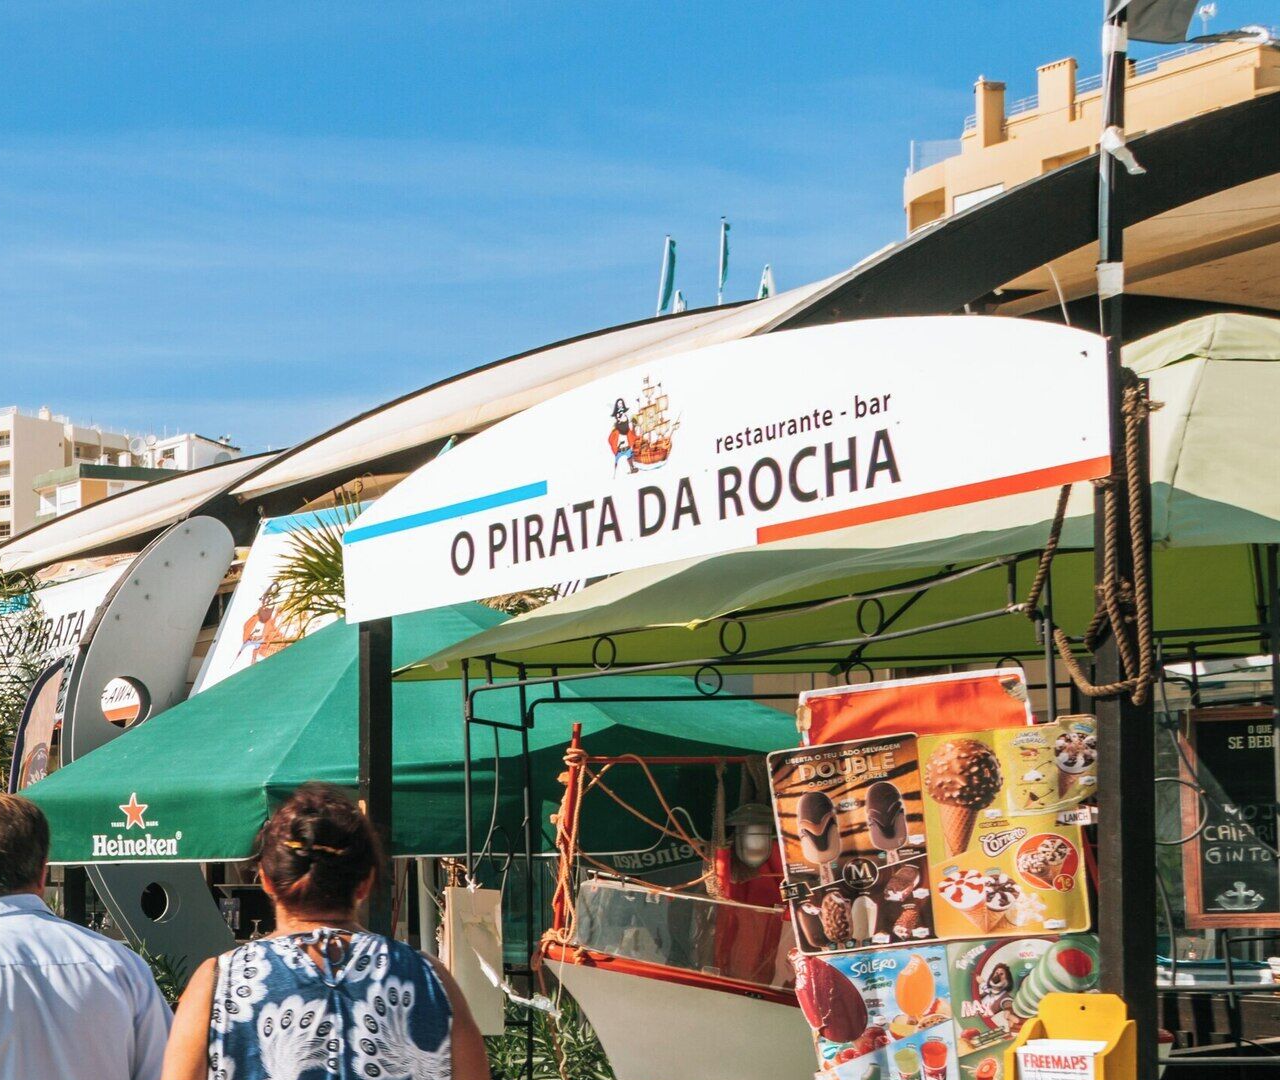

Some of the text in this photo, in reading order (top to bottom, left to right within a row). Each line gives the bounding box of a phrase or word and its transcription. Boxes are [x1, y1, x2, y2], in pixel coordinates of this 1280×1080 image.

[715, 407, 833, 454] restaurante
[854, 392, 892, 419] bar
[450, 428, 902, 576] O PIRATA DA ROCHA
[839, 749, 860, 757] LADO
[861, 743, 901, 754] SELVAGEM
[1228, 736, 1245, 749] SE
[798, 751, 897, 782] DOUBLE
[92, 833, 178, 856] Heineken
[979, 827, 1028, 858] Cornetto
[850, 958, 897, 978] SOLERO
[1024, 1053, 1088, 1071] FREEMAPS
